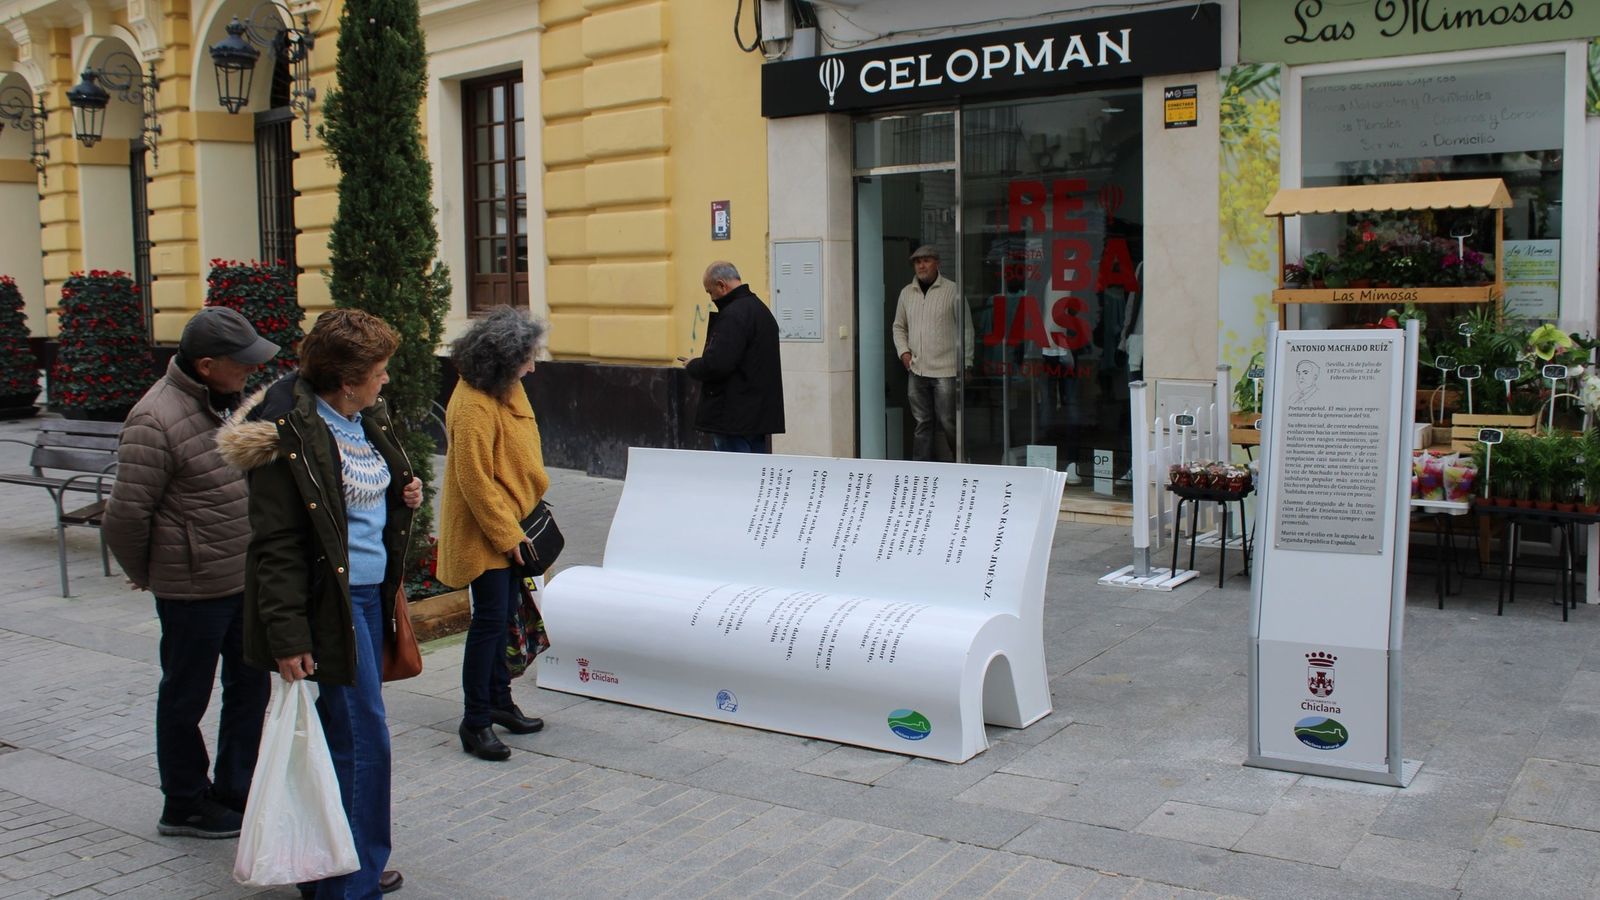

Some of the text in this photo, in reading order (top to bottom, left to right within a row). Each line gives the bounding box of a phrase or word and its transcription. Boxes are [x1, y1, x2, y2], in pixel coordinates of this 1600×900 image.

[1284, 0, 1574, 44] Las Mimosas
[860, 28, 1132, 94] CELOPMAN
[1433, 134, 1495, 146] Domicilio
[1008, 179, 1088, 232] RE
[1052, 240, 1140, 291] BA
[1333, 290, 1419, 302] Las Mimosas
[984, 296, 1090, 350] JAS
[1370, 342, 1388, 352] RUÍZ
[762, 468, 766, 476] un
[904, 475, 909, 484] en
[962, 478, 968, 487] de
[819, 470, 828, 498] Quebró
[920, 476, 929, 506] brillaba
[780, 492, 789, 510] dulce
[900, 486, 909, 508] donde
[908, 476, 920, 518] iluminando
[1002, 490, 1011, 515] JUAN
[760, 500, 769, 521] mirtos
[832, 472, 854, 549] de un oculto ruiseñor.
[859, 500, 868, 522] fuente
[876, 474, 900, 562] sollozando intermitente.
[923, 510, 933, 532] agudo
[772, 513, 783, 539] melodía
[796, 514, 809, 543] surtidor.
[809, 515, 818, 535] racha
[843, 516, 854, 543] escuchó
[913, 517, 922, 533] luna
[963, 512, 973, 533] noche
[899, 530, 909, 551] fuente
[917, 534, 927, 556] ciprés
[993, 518, 1007, 552] RAMÓN
[886, 539, 895, 559] surtía
[945, 538, 955, 565] serena.
[984, 554, 997, 600] JIMÉNEZ.
[770, 622, 780, 642] violín
[825, 645, 835, 670] fuente
[880, 639, 888, 660] amor
[889, 633, 904, 663] lamento
[591, 672, 619, 684] Chiclana
[1301, 702, 1340, 714] Chiclana
